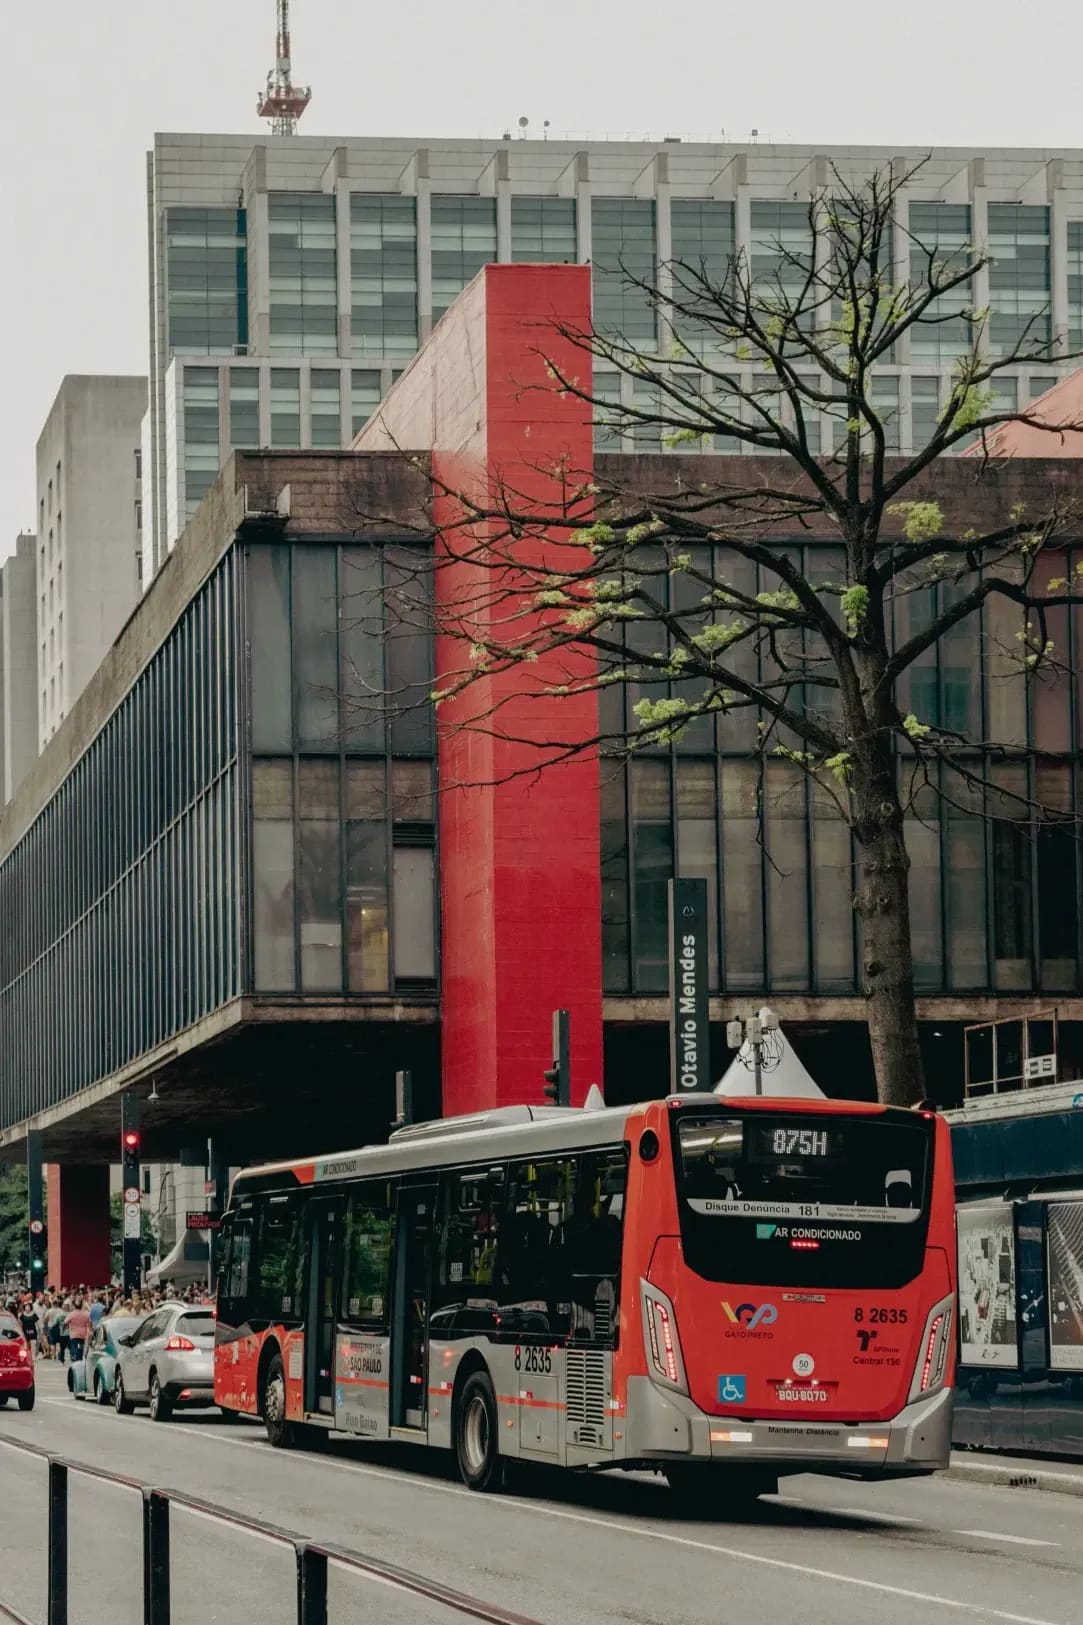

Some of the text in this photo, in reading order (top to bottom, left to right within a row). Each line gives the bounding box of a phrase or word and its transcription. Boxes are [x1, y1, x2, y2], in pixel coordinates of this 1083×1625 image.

[680, 934, 698, 1088] Otavio Mendes
[773, 1129, 827, 1156] 875H
[705, 1202, 739, 1213] Disque
[743, 1203, 790, 1214] Denúncia
[798, 1205, 820, 1217] 181
[774, 1227, 861, 1240] AR CONDICIONADO
[854, 1308, 908, 1324] 8 2635
[362, 1357, 382, 1374] PAULO
[514, 1345, 551, 1373] 8 2635
[799, 1359, 809, 1369] 50
[853, 1356, 884, 1366] Central
[768, 1426, 803, 1435] Mantenha
